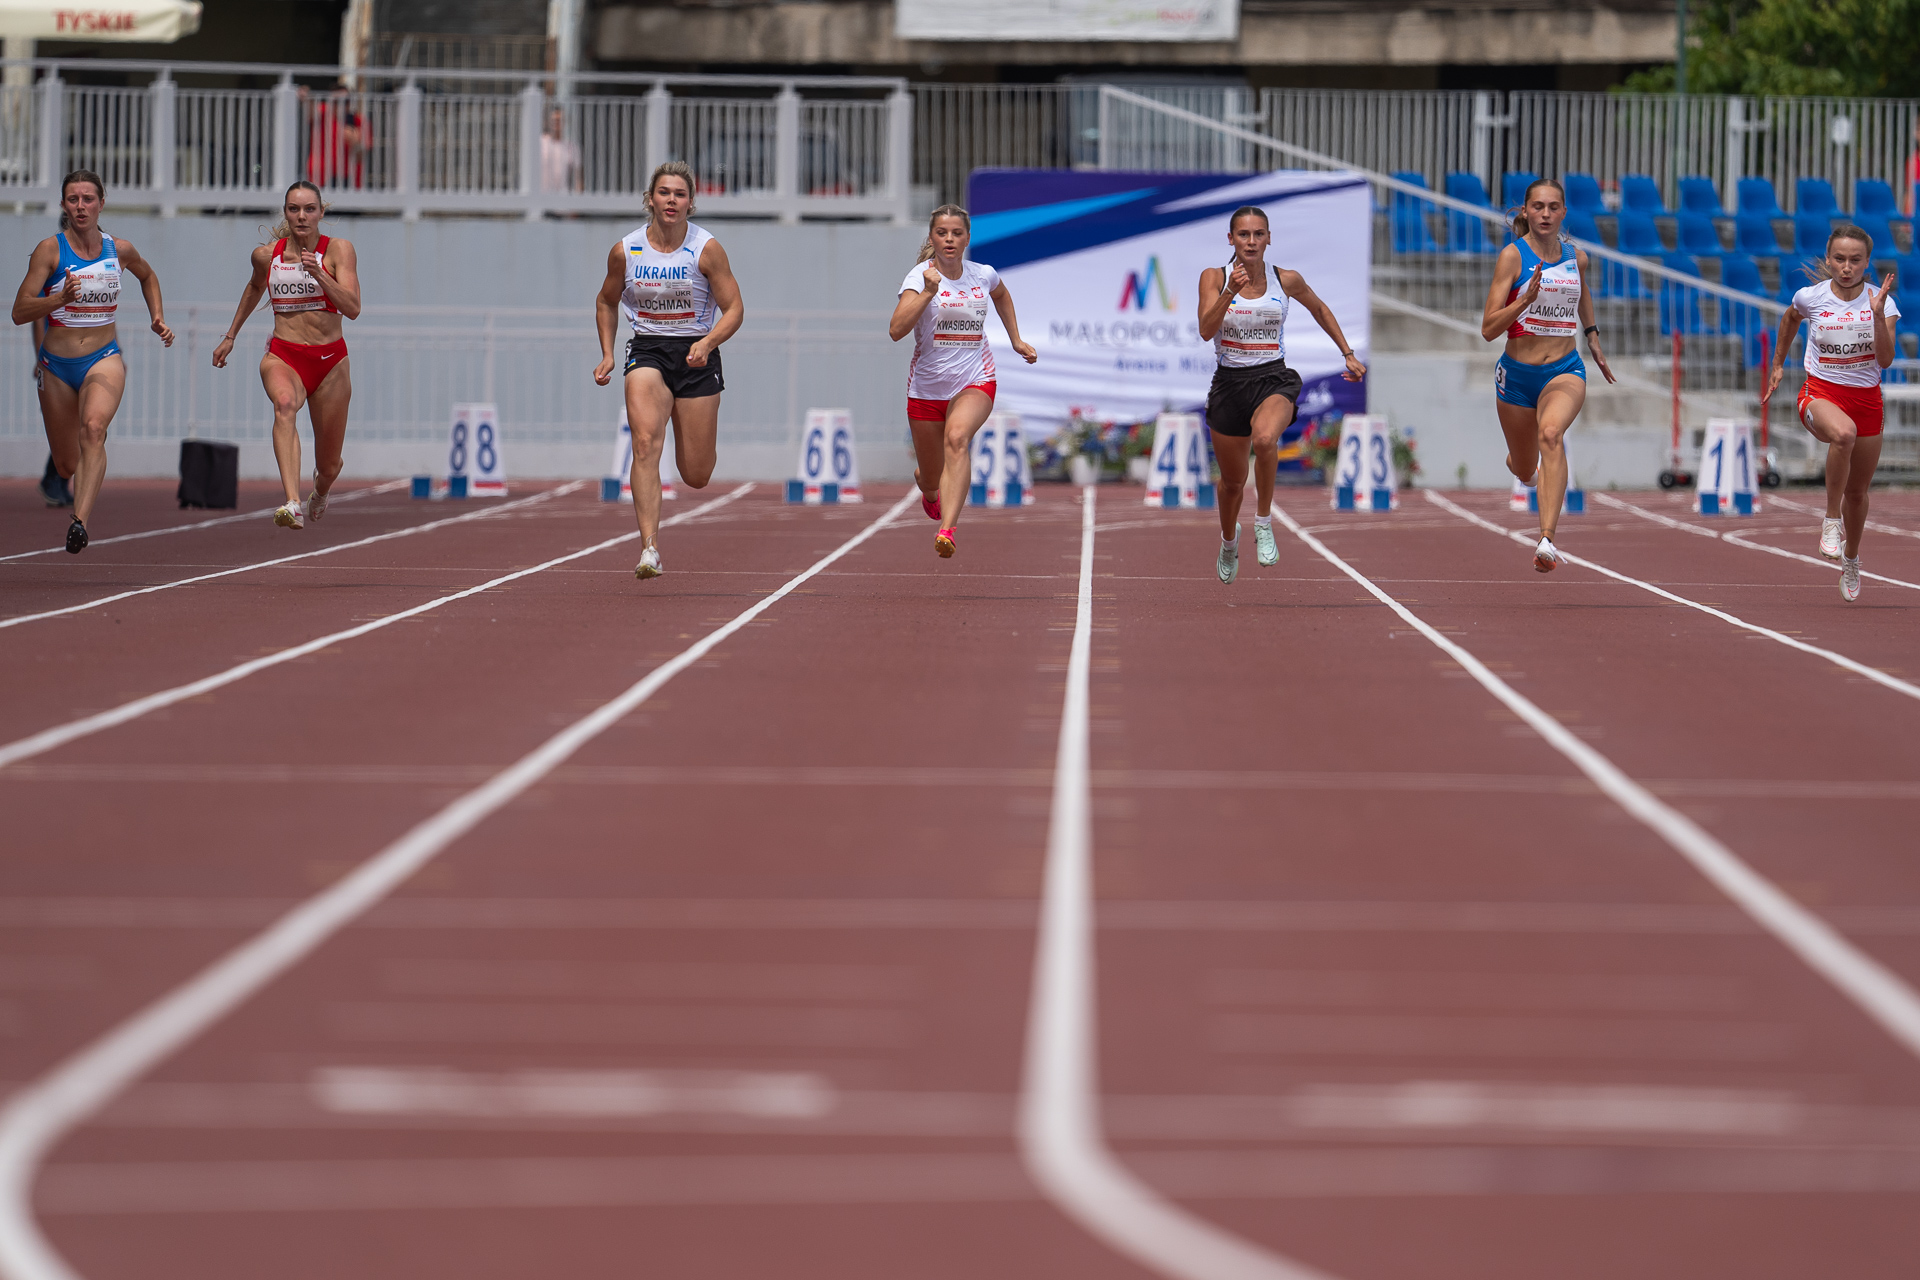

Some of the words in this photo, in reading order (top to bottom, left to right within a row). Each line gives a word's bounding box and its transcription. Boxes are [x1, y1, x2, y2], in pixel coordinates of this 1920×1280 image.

[55, 10, 136, 32] TYSKIE
[273, 283, 316, 295] KOCSIS
[635, 265, 688, 279] UKRAINE
[639, 299, 692, 311] LOCHMAN
[936, 319, 984, 331] KWASIBORSK
[1529, 304, 1575, 318] LAMAČOVÁ
[1223, 327, 1277, 340] HONCHARENKO
[1819, 342, 1872, 355] SOBCZYK
[451, 422, 467, 473] 8
[478, 422, 496, 474] 8
[806, 427, 823, 478] 6
[832, 427, 851, 479] 6
[977, 430, 994, 482] 5
[1005, 430, 1022, 483] 5
[1157, 432, 1176, 486] 4
[1186, 432, 1201, 486] 4
[1343, 434, 1360, 485] 3
[1371, 434, 1387, 485] 3
[1709, 437, 1723, 490] 1
[1736, 437, 1749, 490] 1
